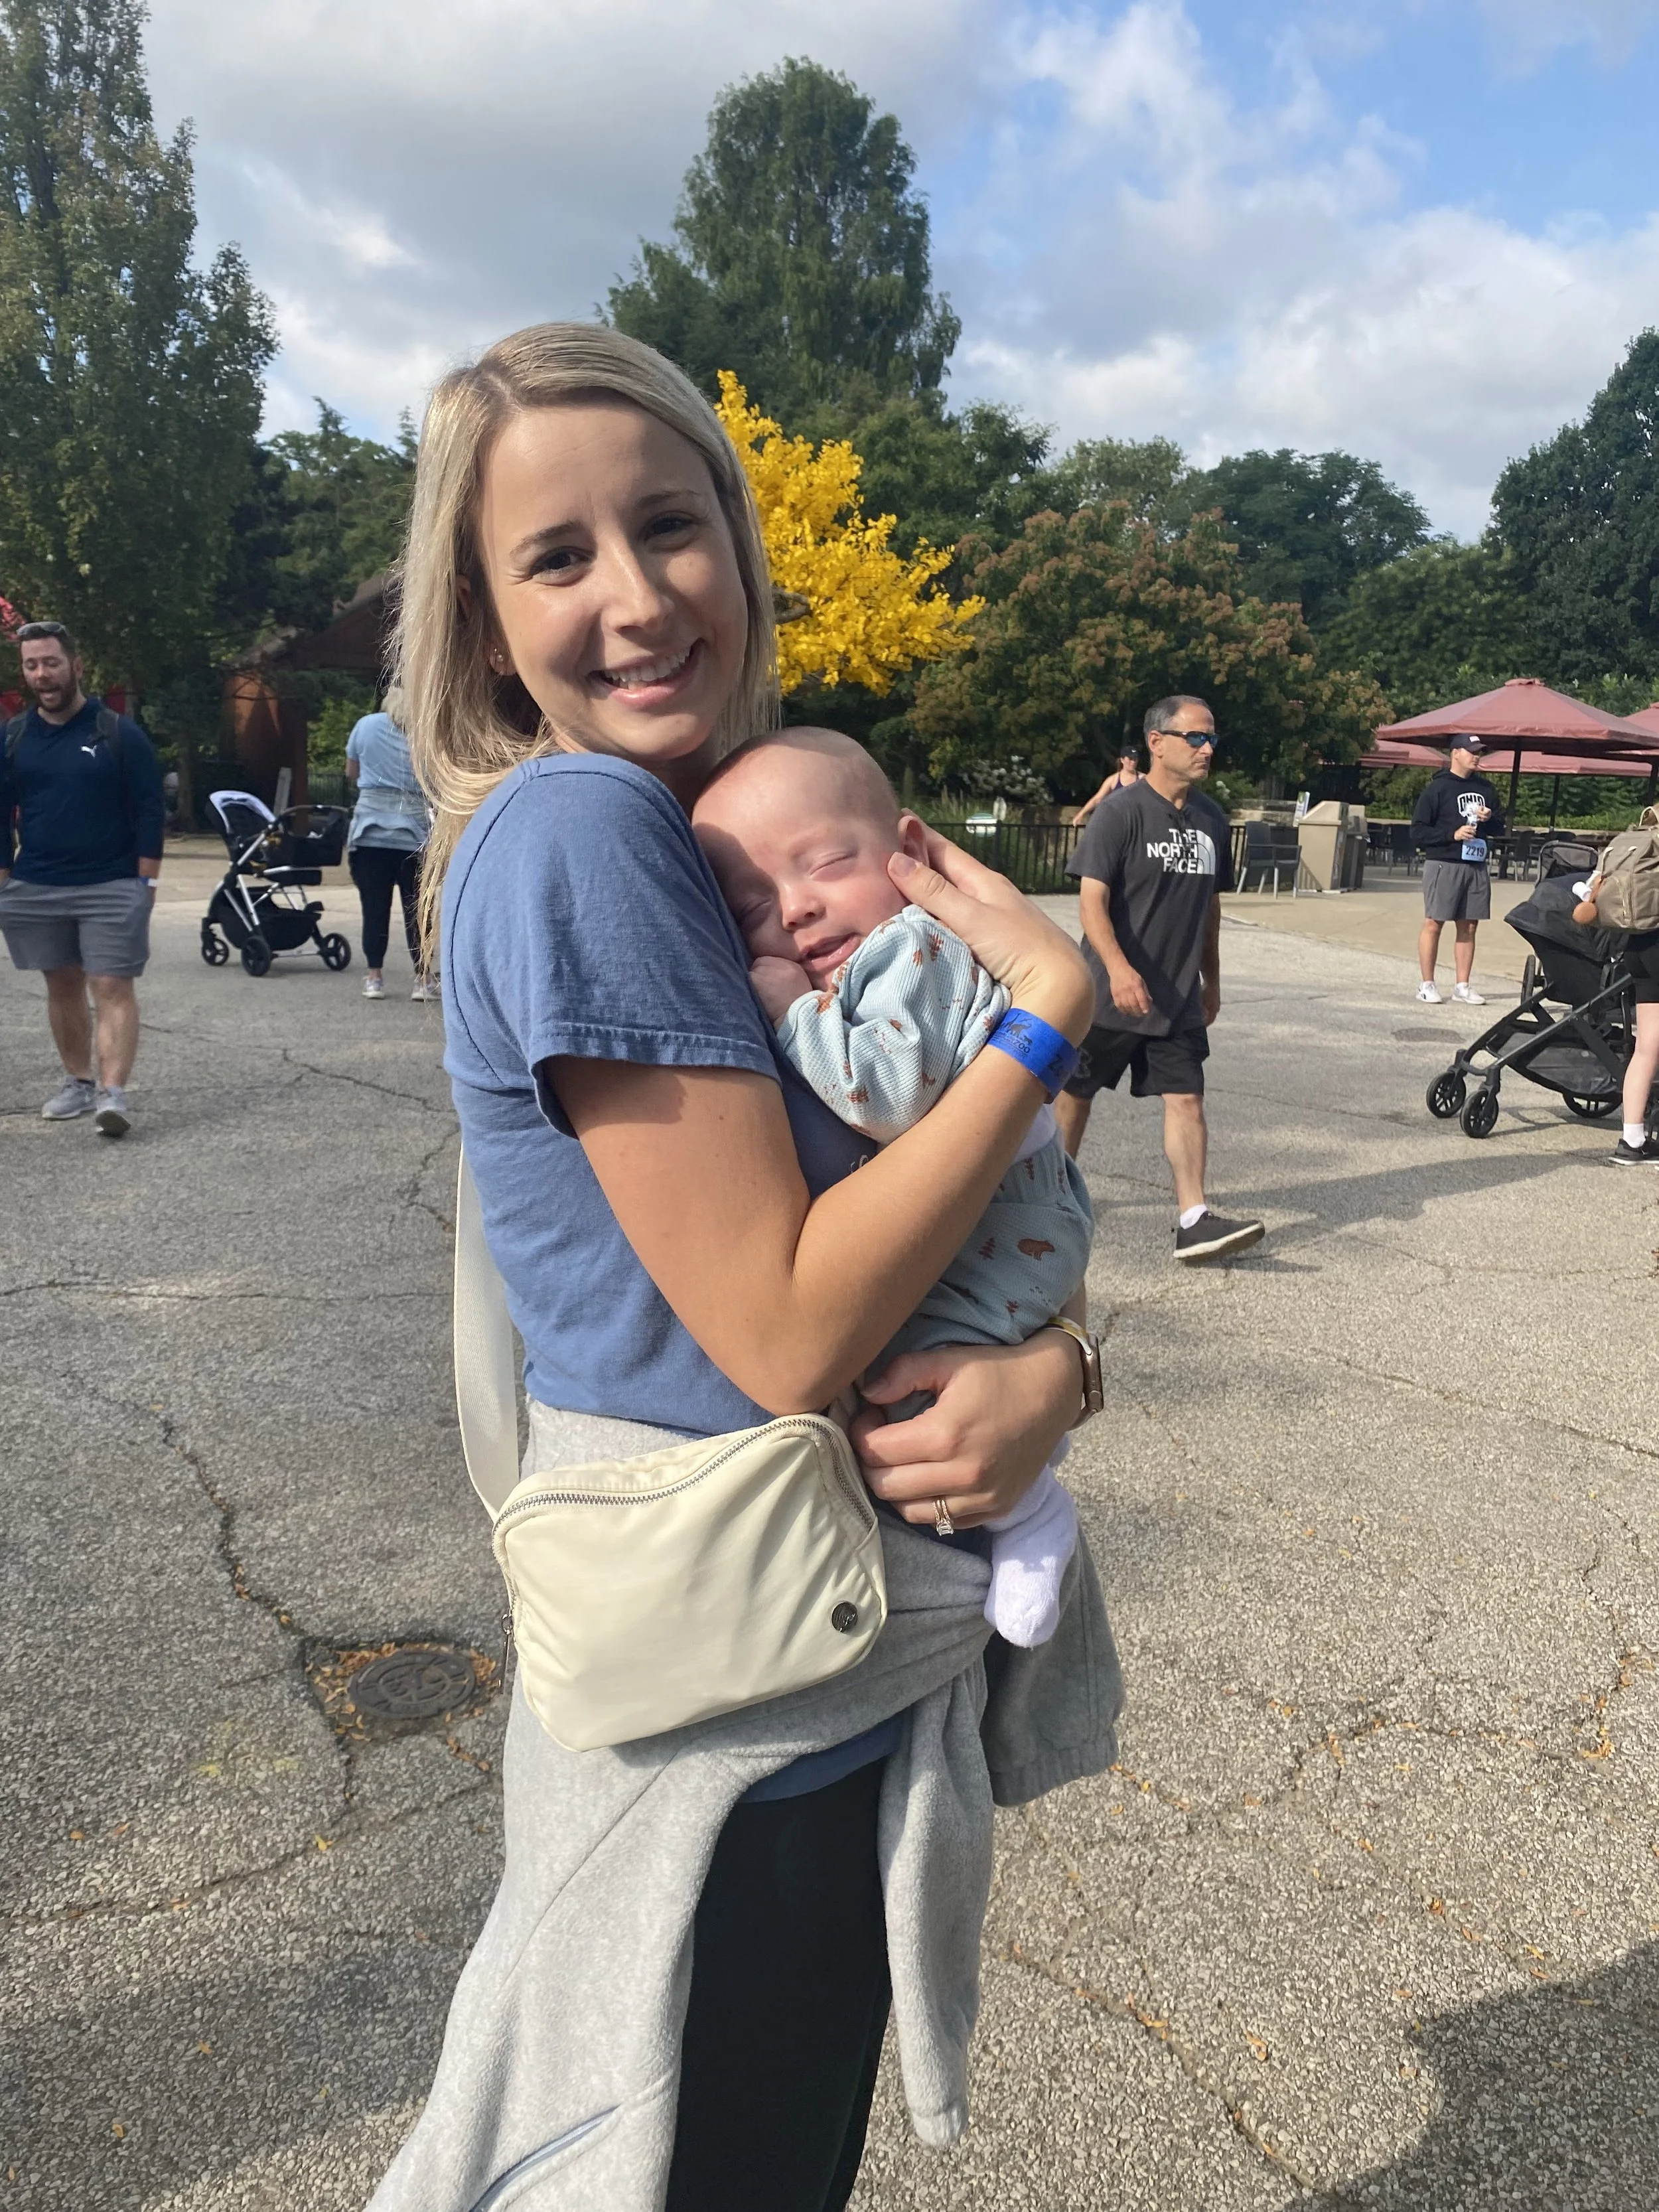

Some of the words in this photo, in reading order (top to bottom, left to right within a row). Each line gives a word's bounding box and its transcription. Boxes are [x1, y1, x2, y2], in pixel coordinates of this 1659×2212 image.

[1168, 828, 1196, 844] THE
[1465, 845, 1484, 857] 2219
[1163, 857, 1197, 874] FACE
